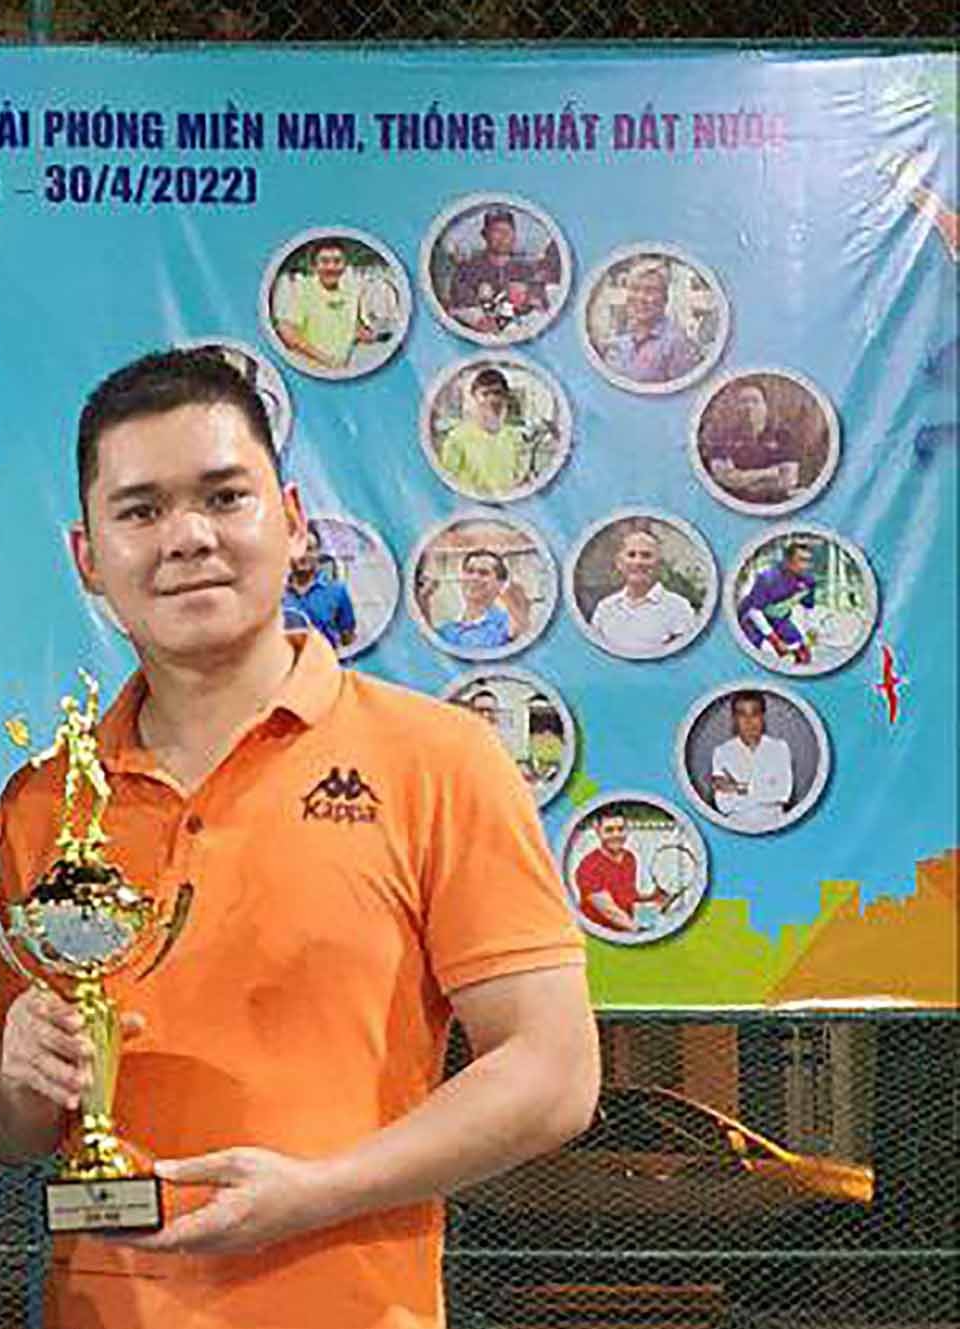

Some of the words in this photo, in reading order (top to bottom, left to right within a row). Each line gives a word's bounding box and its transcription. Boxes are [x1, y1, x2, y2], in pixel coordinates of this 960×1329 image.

[44, 104, 165, 150] PHÓNG
[277, 113, 365, 154] NAM,
[45, 164, 257, 206] 30/4/2022)
[300, 796, 380, 824] Kappa
